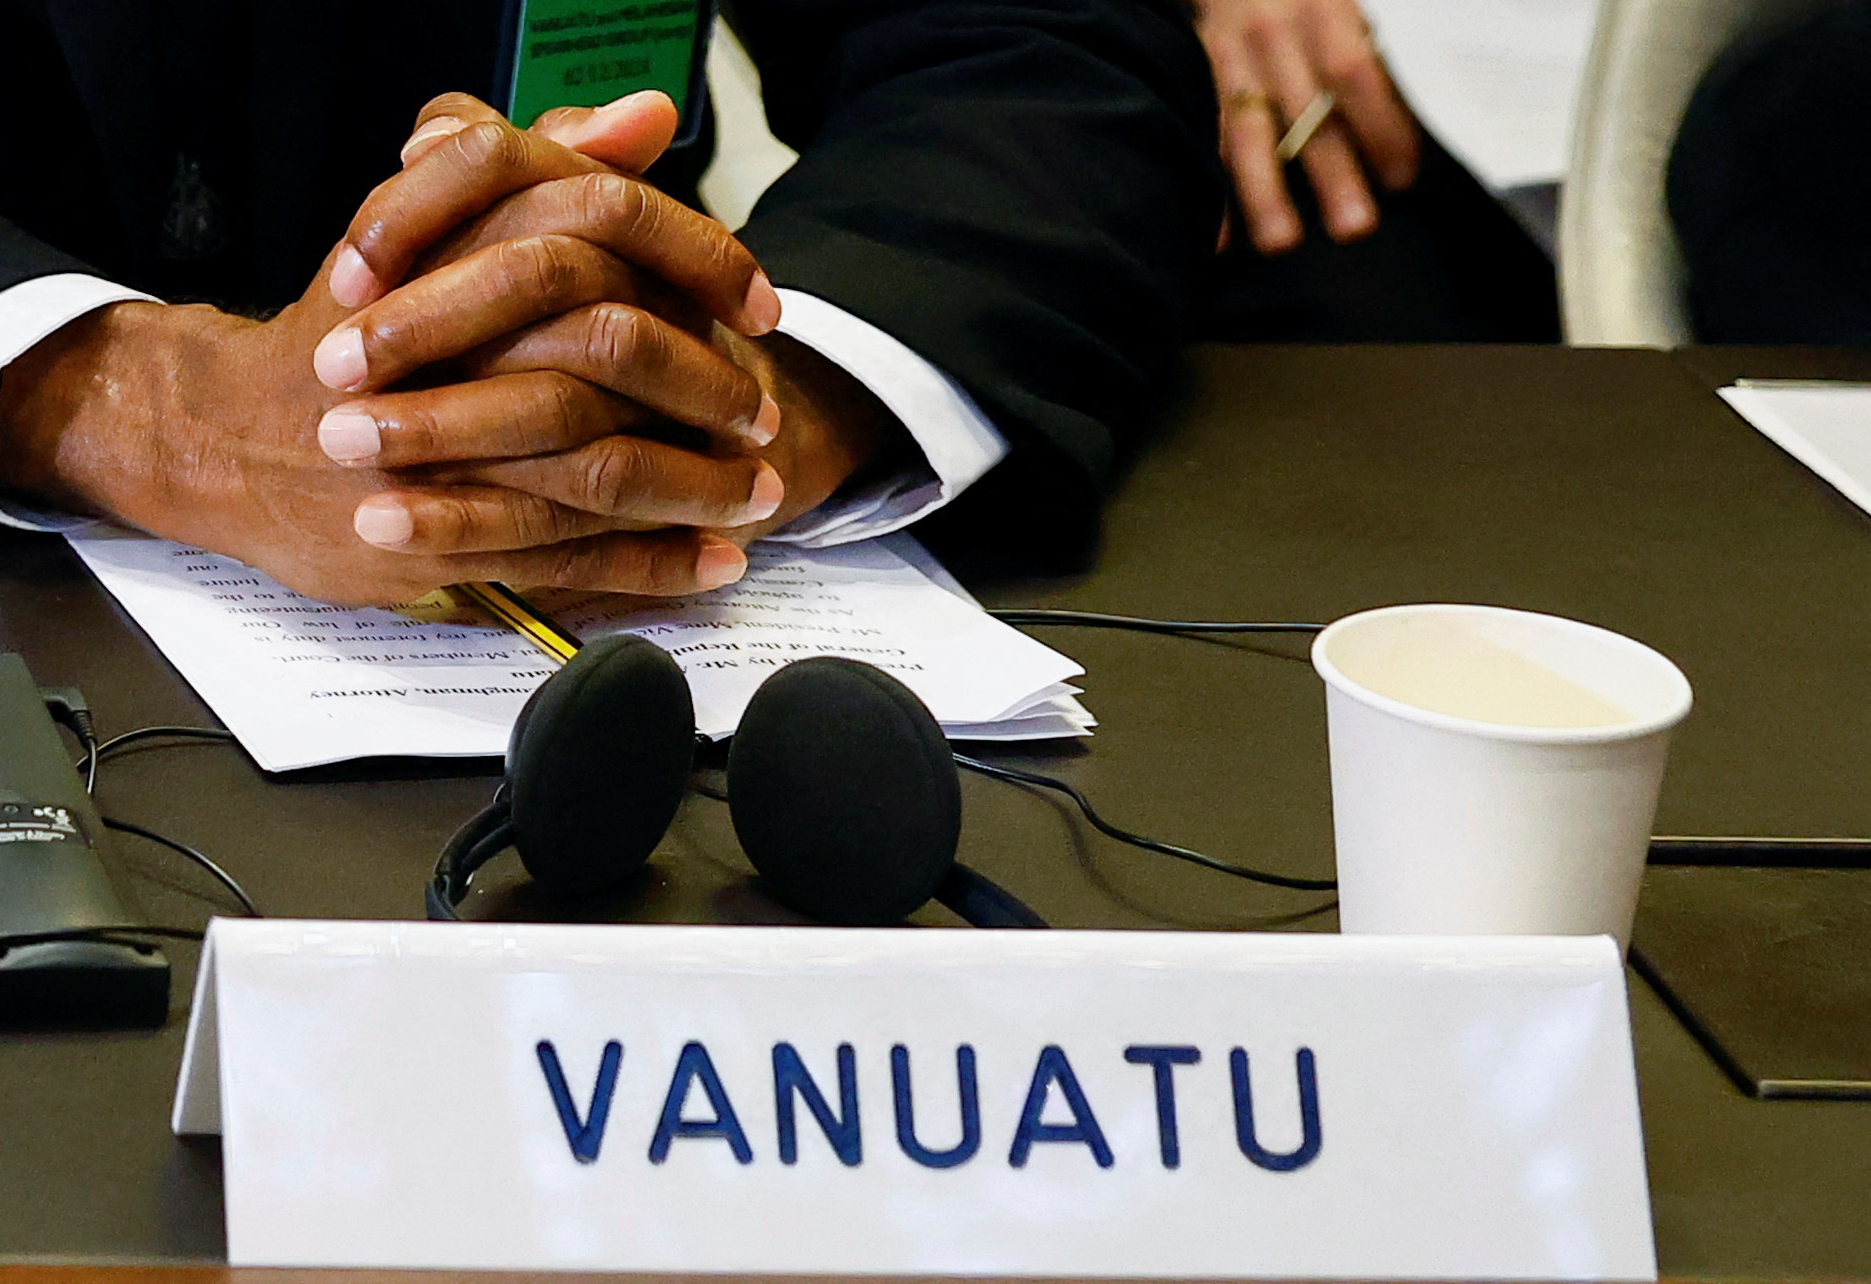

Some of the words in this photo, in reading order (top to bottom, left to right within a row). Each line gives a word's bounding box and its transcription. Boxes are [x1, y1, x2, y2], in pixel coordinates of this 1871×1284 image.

[408, 651, 509, 660] Members
[815, 644, 905, 656] General
[309, 689, 407, 699] Attorney
[536, 1039, 1322, 1173] VANUATU
